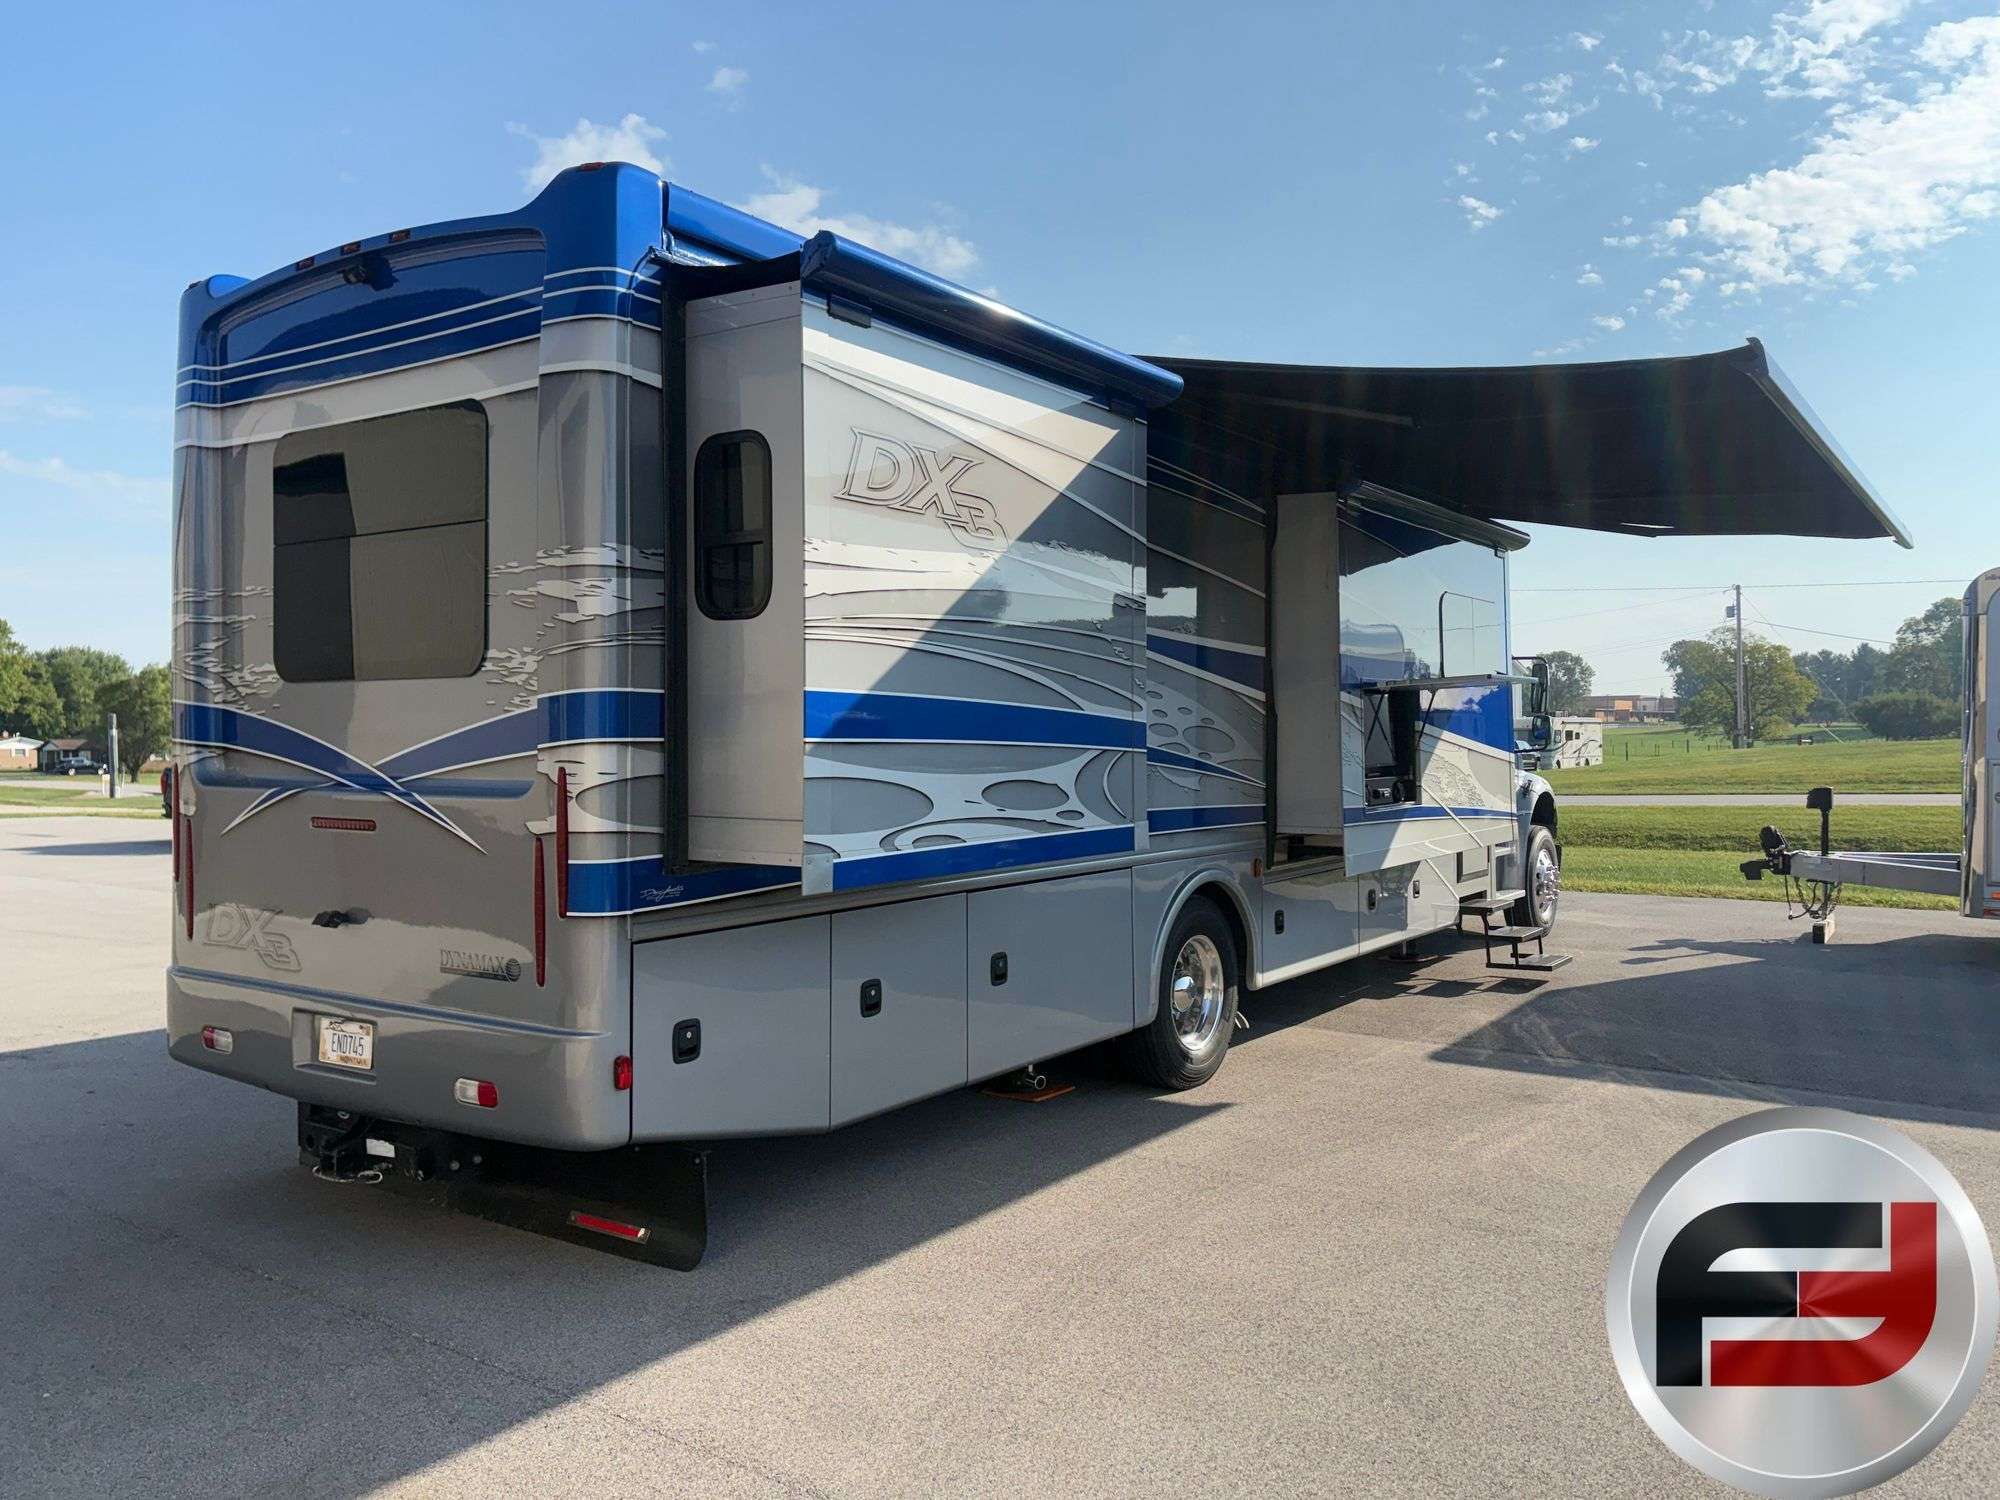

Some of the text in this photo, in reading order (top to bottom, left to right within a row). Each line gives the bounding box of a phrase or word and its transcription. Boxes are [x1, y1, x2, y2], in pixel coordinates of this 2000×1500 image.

[833, 426, 1010, 553] DX3
[201, 902, 303, 974] DX3
[440, 948, 505, 974] DYNAMAX
